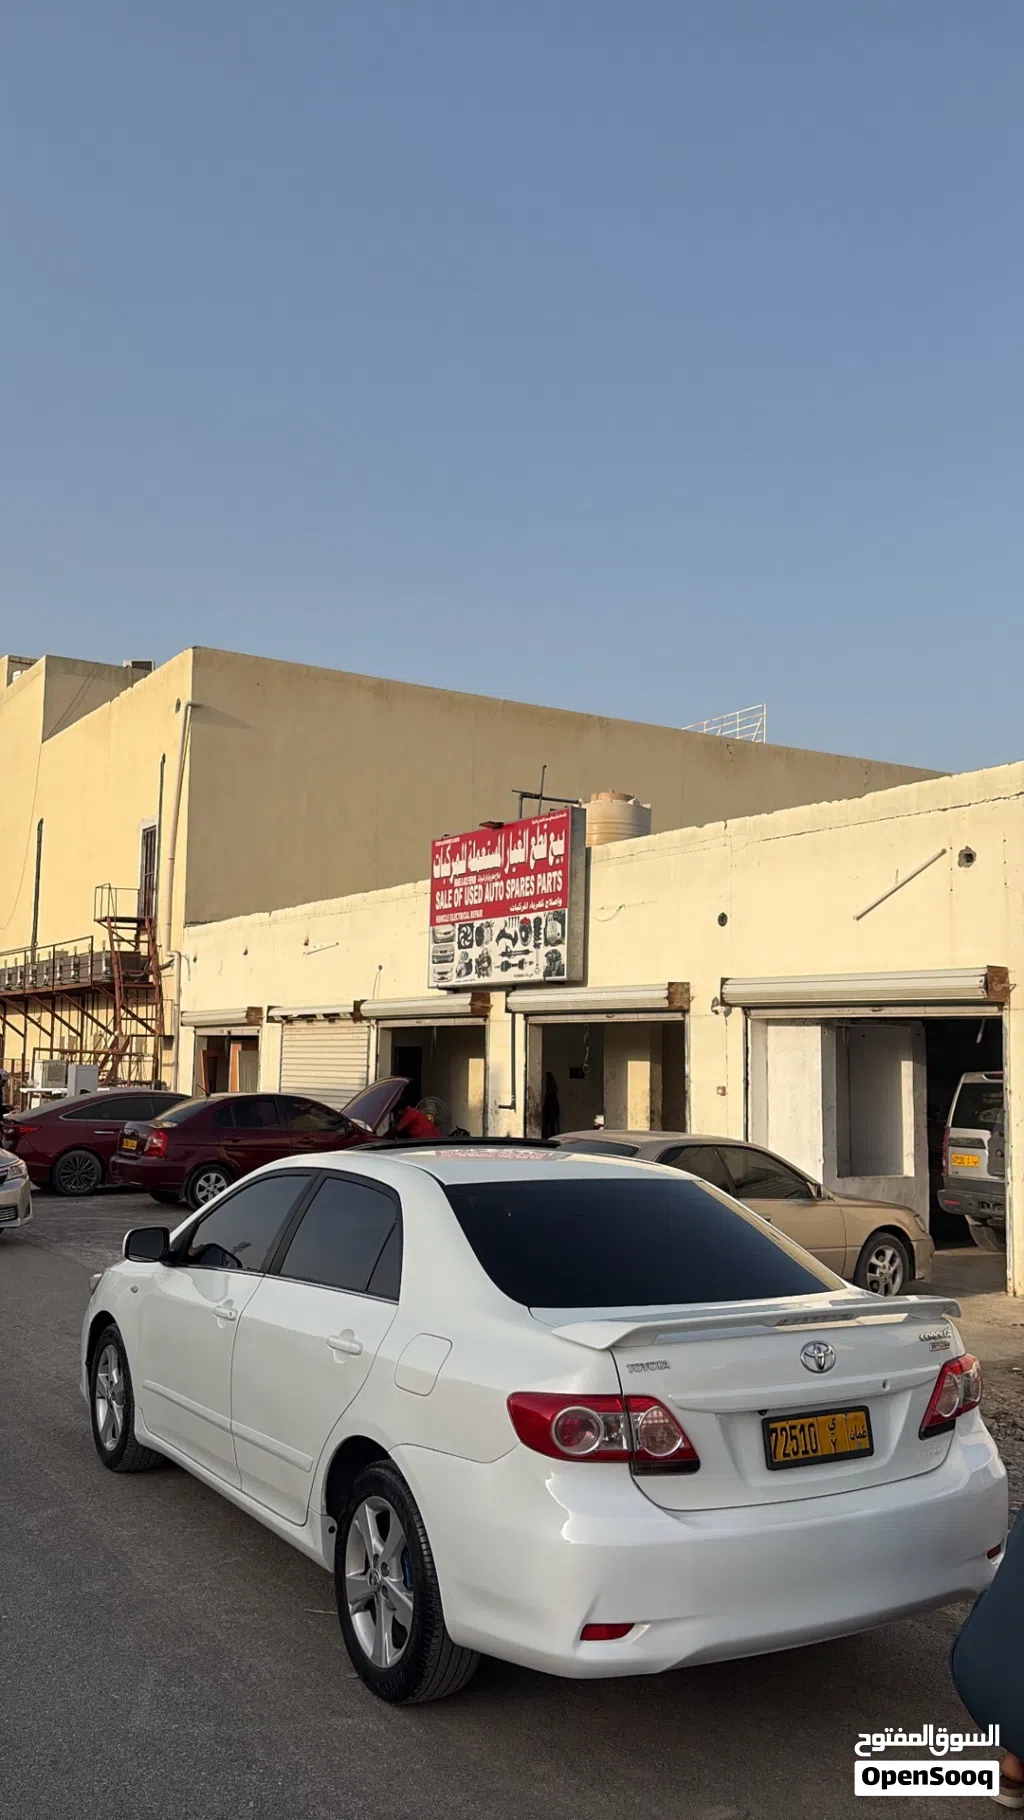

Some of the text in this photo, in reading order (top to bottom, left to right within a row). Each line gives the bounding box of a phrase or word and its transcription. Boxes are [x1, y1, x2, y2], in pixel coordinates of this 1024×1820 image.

[467, 832, 505, 873] المستعملة
[504, 828, 529, 874] الغيار
[530, 823, 548, 870] قطع
[548, 829, 565, 866] بيع
[435, 889, 453, 910] SALE
[453, 887, 464, 908] OF
[464, 884, 483, 906] USED
[484, 880, 504, 903] AUTO
[505, 875, 535, 900] SPARES
[536, 869, 563, 895] PARTS
[626, 1360, 671, 1374] TOYOTA
[769, 1422, 819, 1460] 72510
